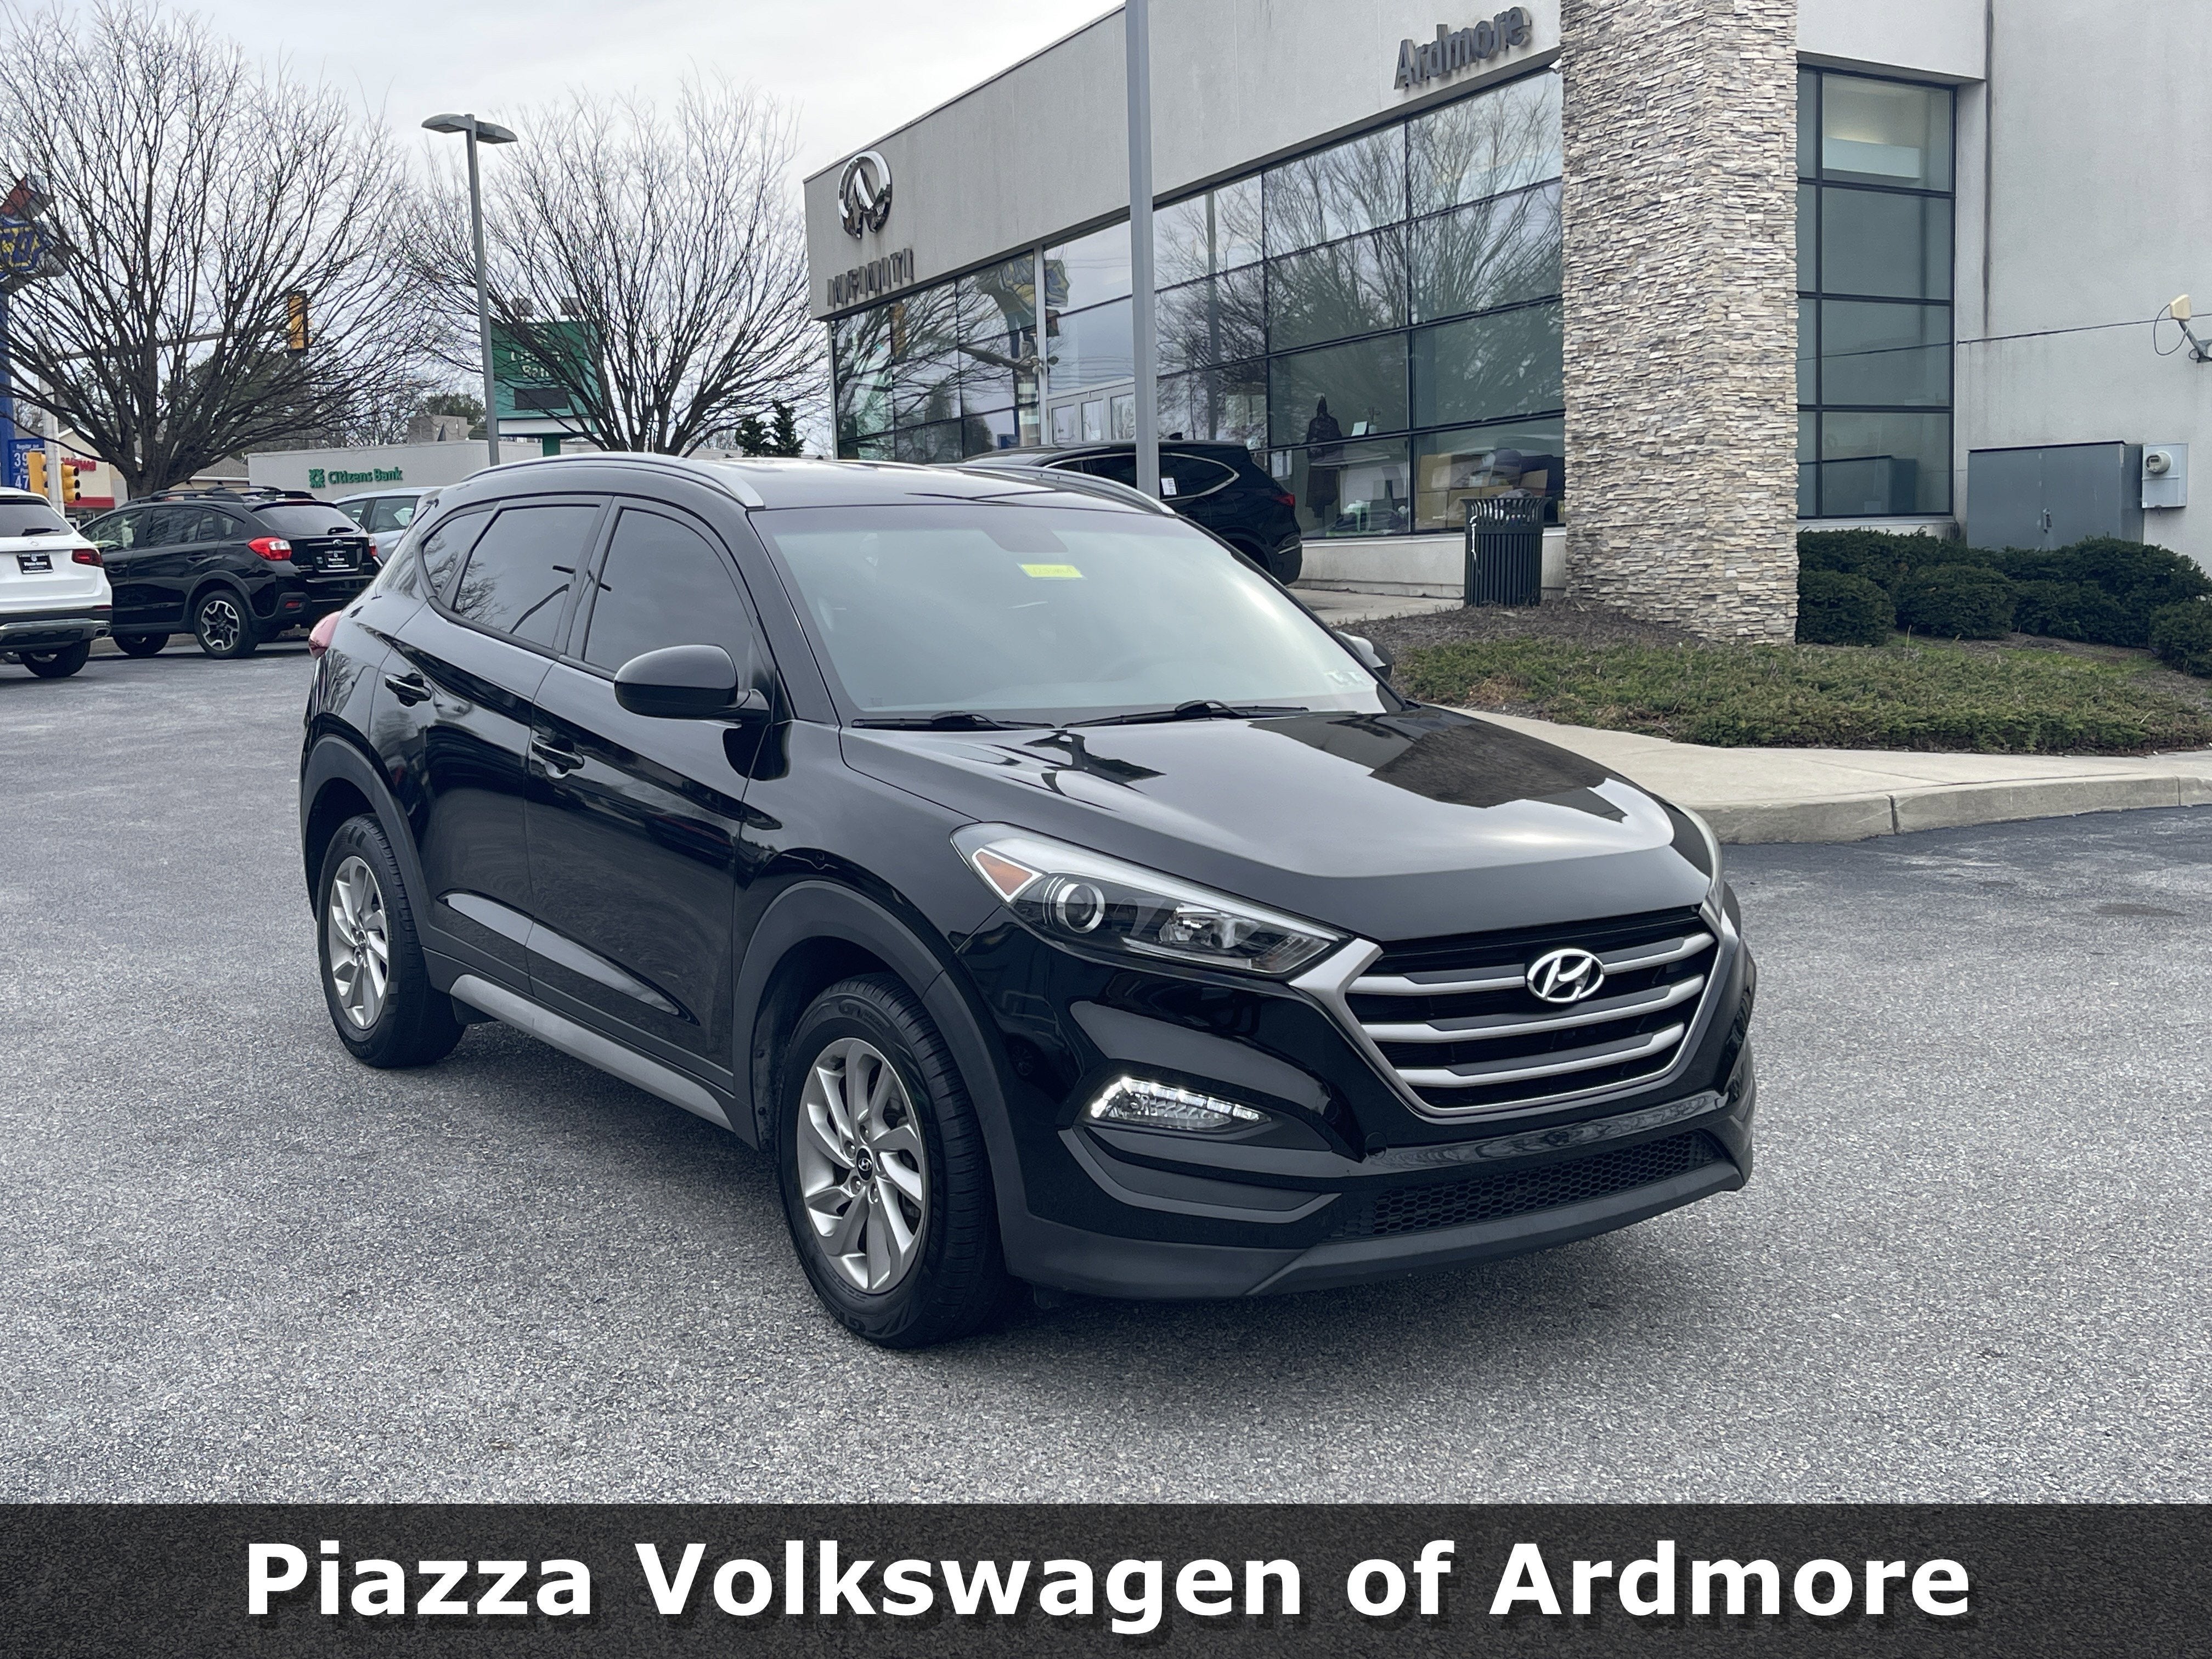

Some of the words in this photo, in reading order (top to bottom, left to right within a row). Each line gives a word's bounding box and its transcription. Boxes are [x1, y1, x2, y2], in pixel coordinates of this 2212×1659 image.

[1394, 7, 1532, 90] Ardmore
[827, 248, 915, 309] INFINITI
[328, 470, 373, 484] Citizens
[374, 466, 403, 481] Bank
